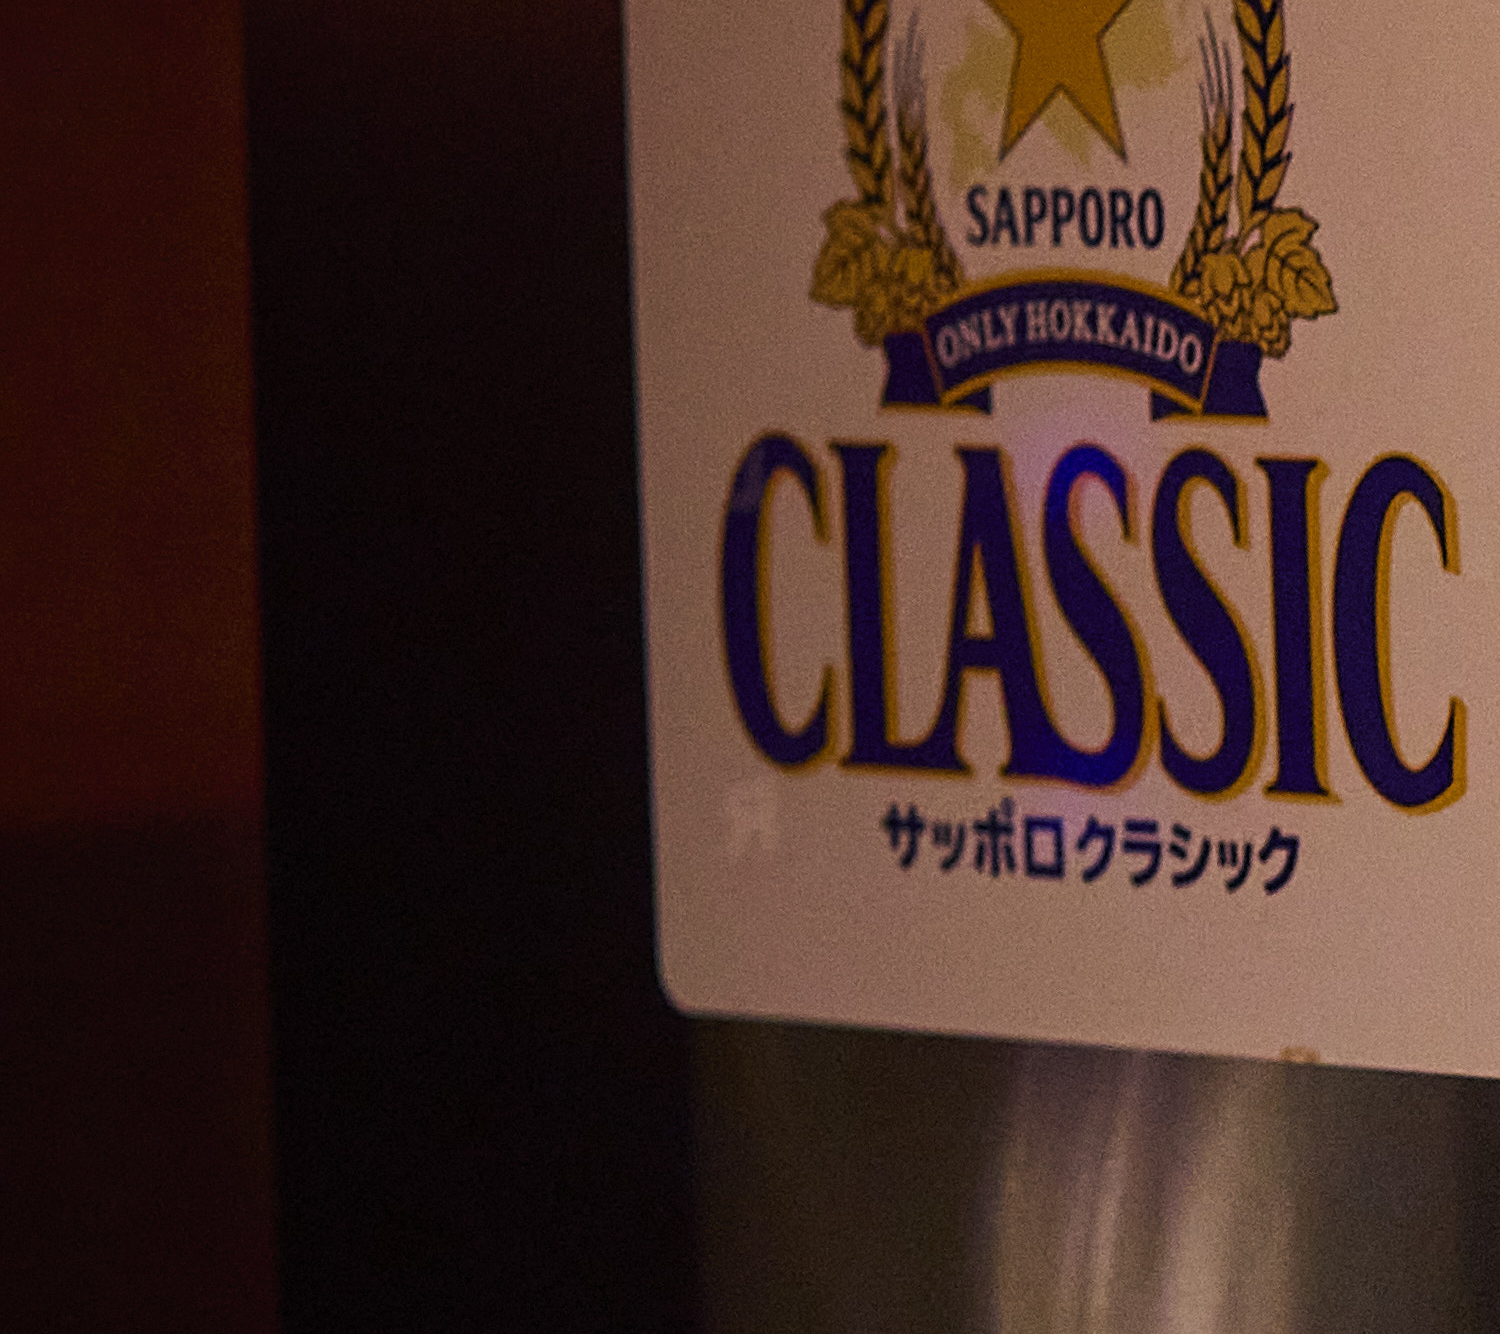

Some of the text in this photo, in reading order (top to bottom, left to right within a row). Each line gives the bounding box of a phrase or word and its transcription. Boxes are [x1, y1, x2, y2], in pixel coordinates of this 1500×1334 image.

[966, 184, 1166, 250] SAPPORO
[935, 299, 1203, 374] ONLY HOKKAIDO
[716, 429, 1467, 815] CLASSIC
[881, 796, 1301, 895] サッポロクラシック
